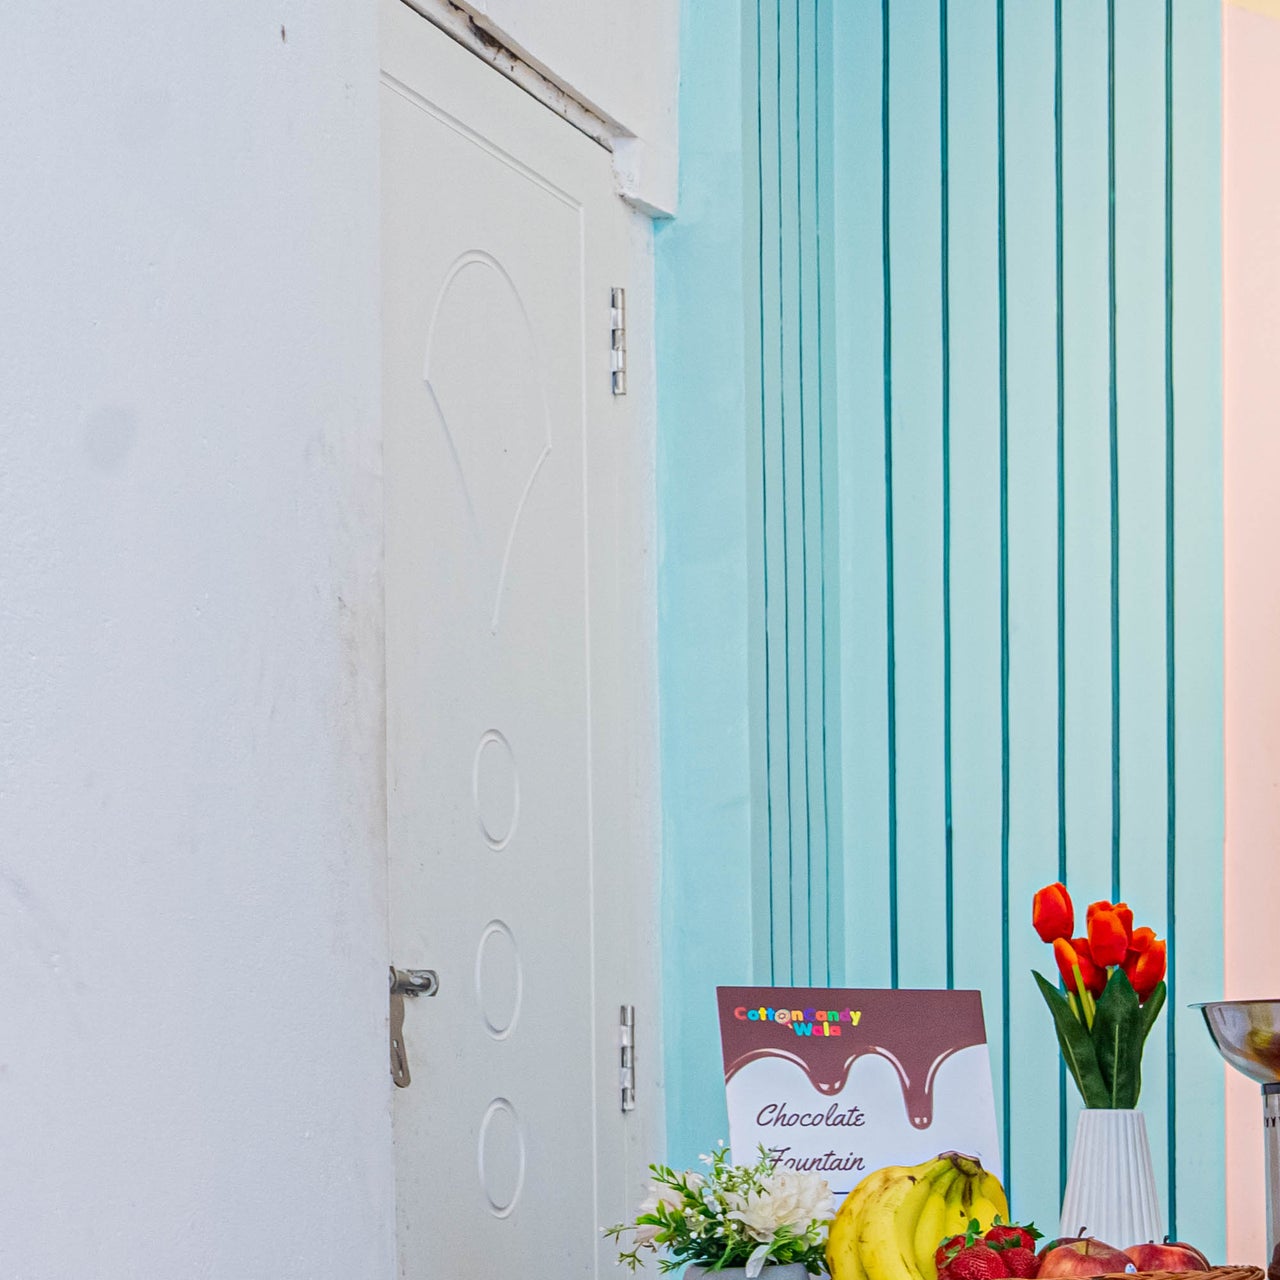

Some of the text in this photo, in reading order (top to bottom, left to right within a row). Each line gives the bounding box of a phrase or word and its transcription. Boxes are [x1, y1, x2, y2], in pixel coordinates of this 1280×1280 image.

[734, 1006, 862, 1027] CottonCandy
[792, 1022, 842, 1037] Wala
[756, 1102, 866, 1127] Chocolate
[767, 1146, 866, 1172] Fountain
